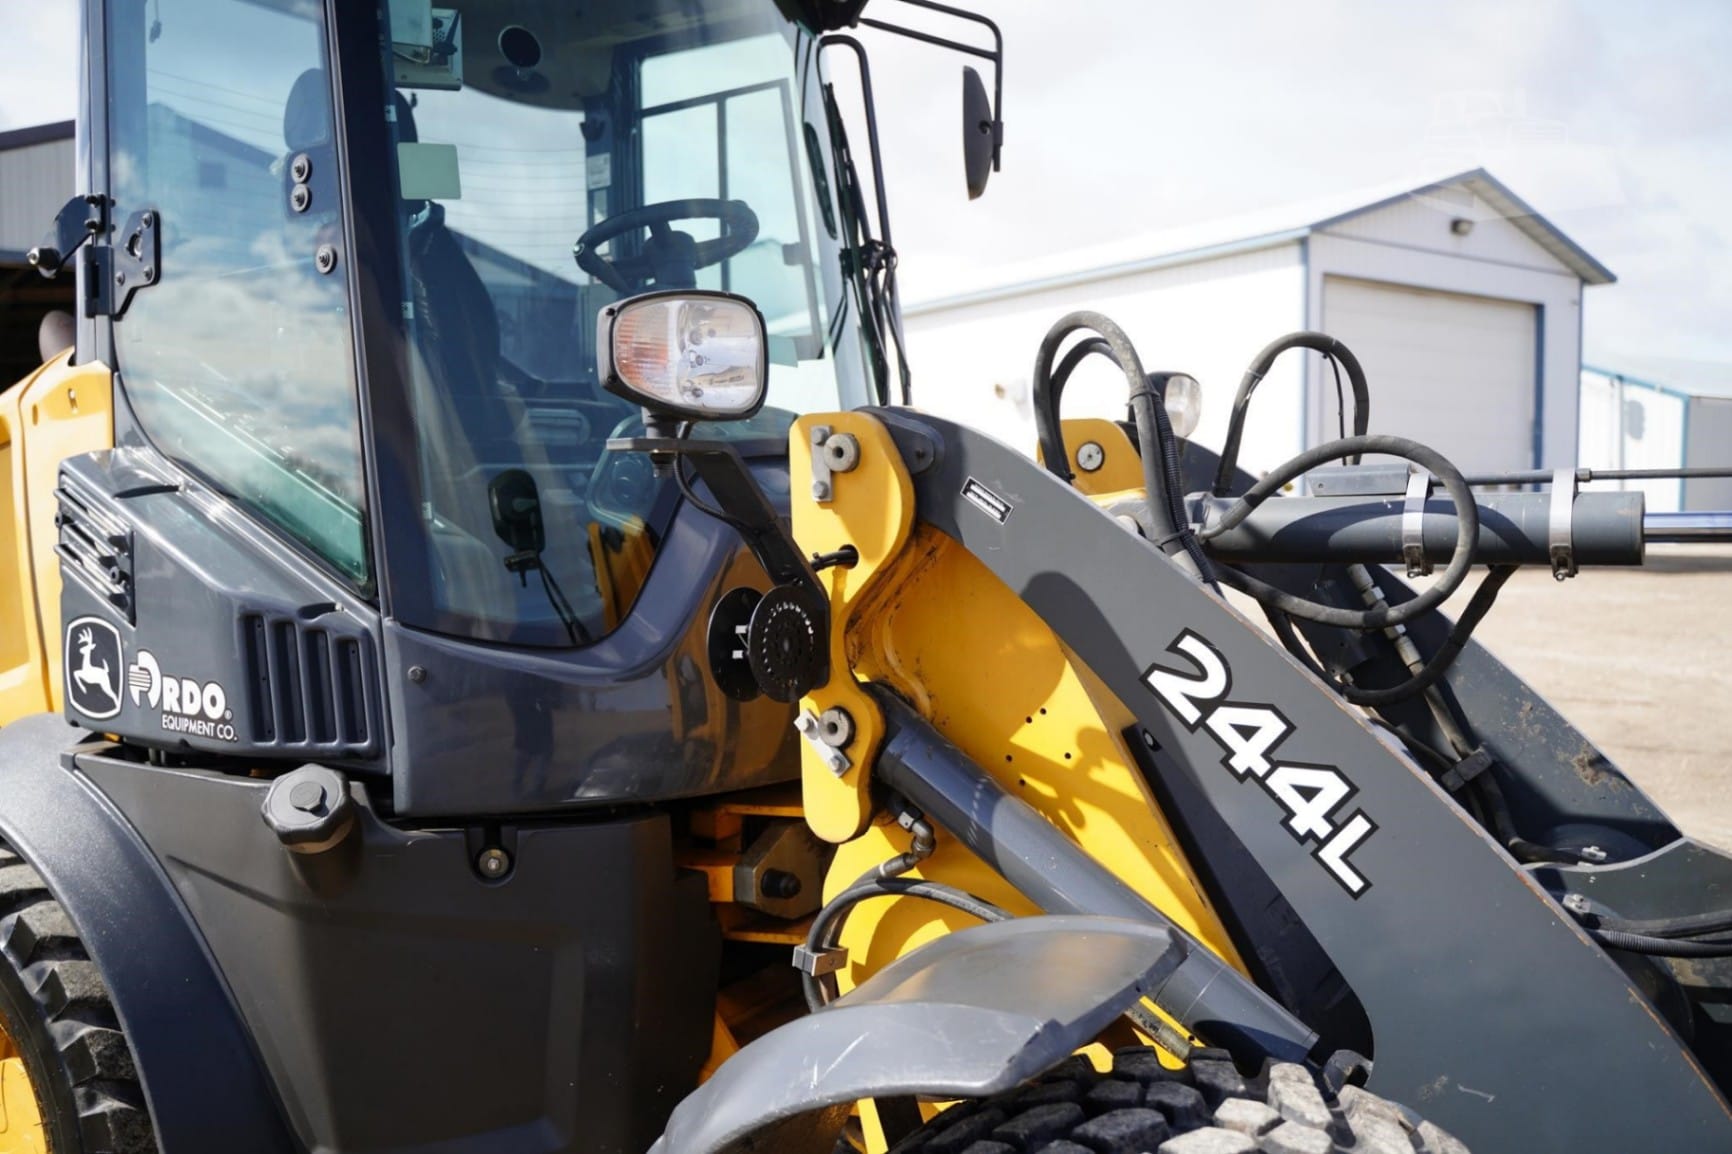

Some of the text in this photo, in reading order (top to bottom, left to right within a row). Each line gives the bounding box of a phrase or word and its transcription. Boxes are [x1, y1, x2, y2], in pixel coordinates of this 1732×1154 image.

[162, 714, 238, 741] EQUIPMENT CO.
[1141, 628, 1378, 898] 244L
